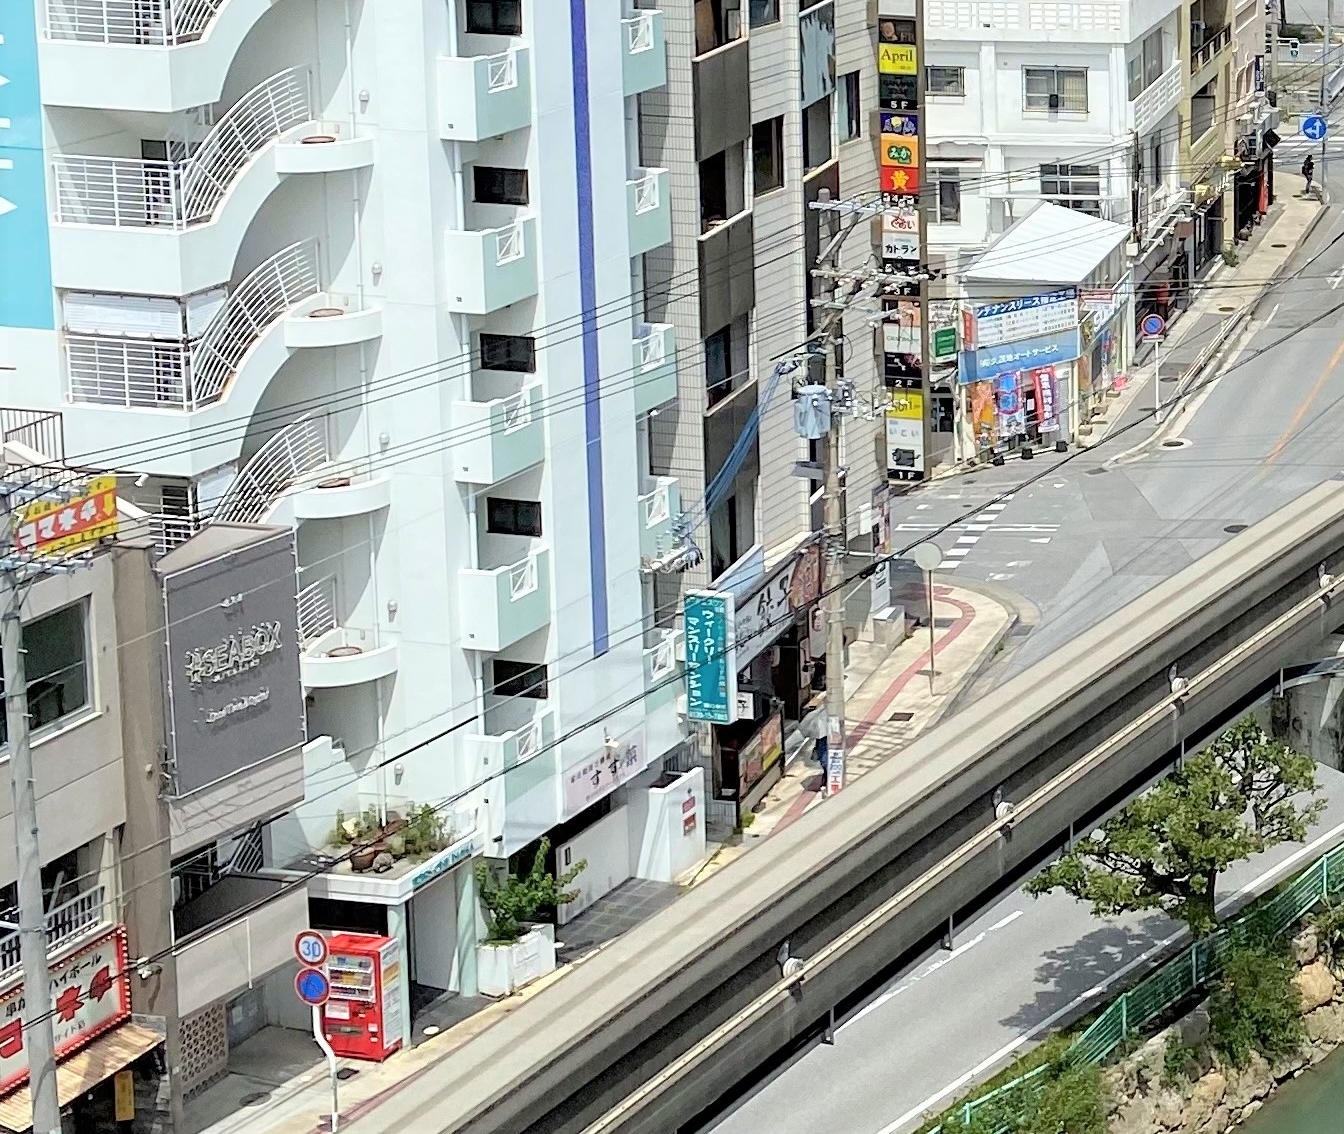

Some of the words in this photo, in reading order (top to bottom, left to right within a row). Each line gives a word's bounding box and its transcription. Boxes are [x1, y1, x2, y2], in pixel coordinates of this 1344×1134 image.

[881, 48, 913, 63] April
[885, 244, 917, 254] カトラン
[301, 940, 322, 958] 30
